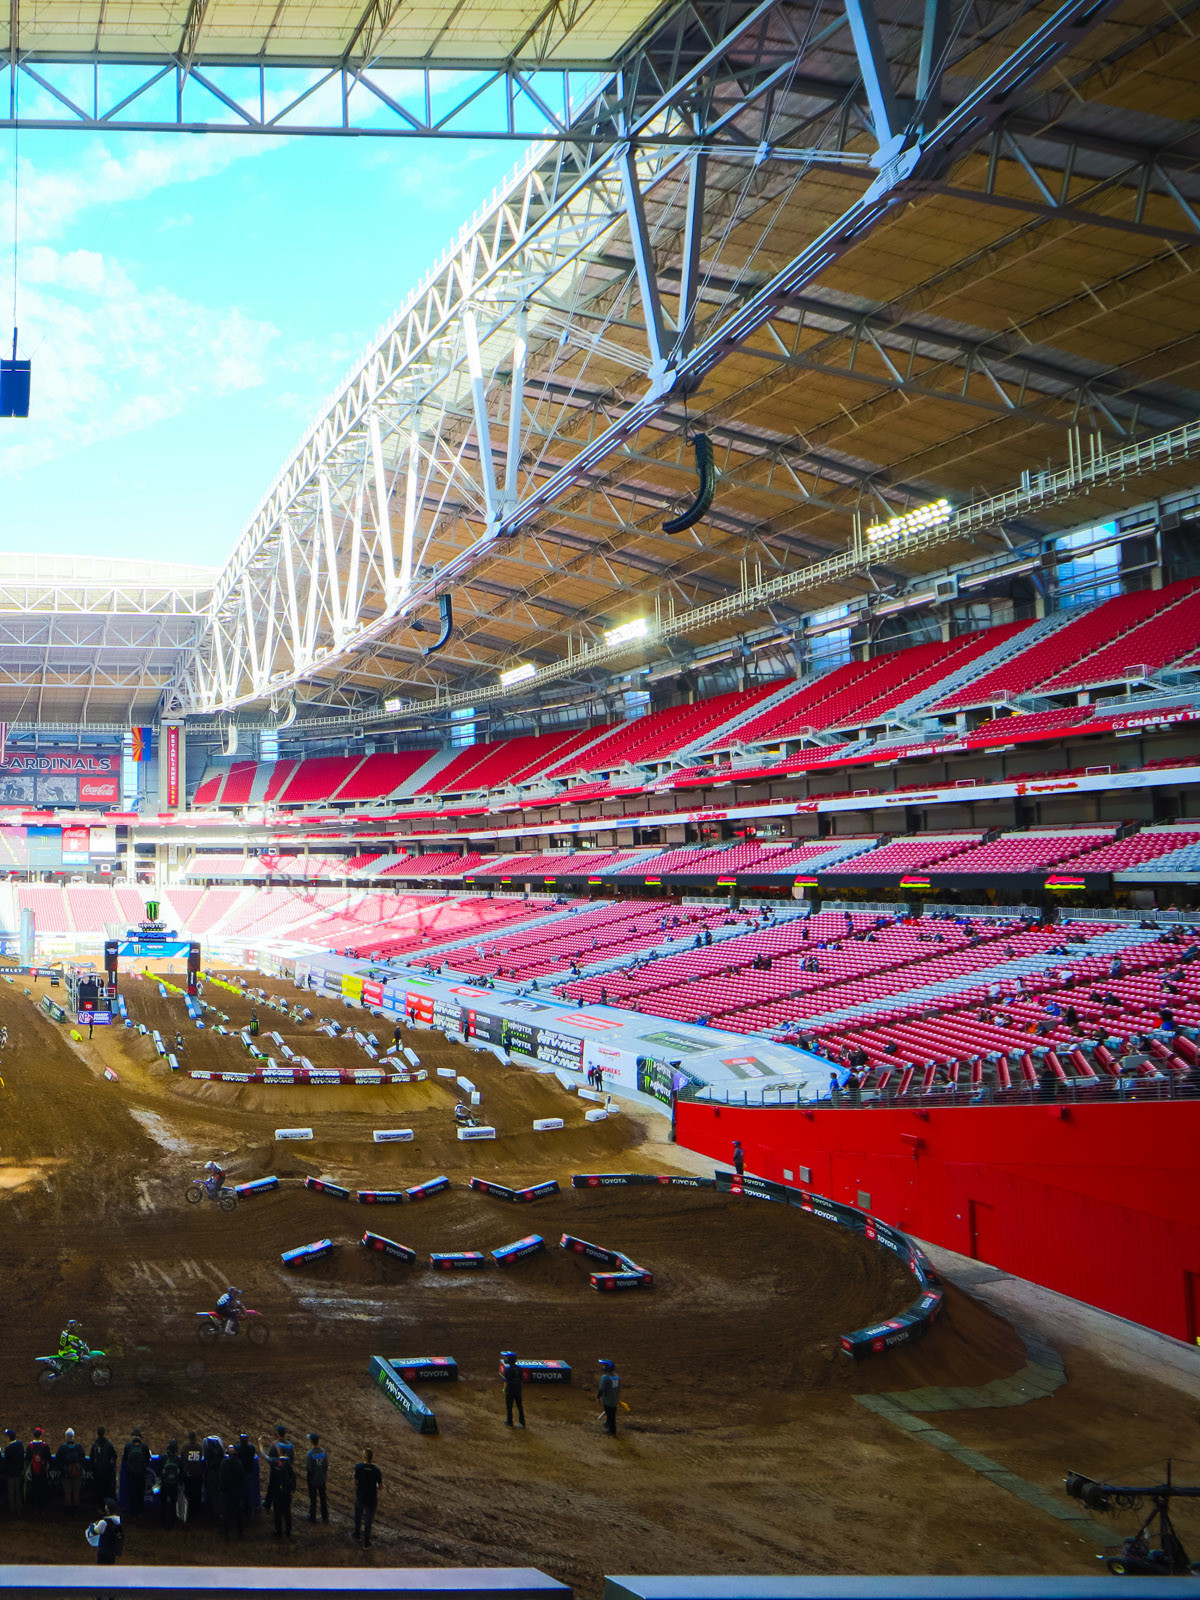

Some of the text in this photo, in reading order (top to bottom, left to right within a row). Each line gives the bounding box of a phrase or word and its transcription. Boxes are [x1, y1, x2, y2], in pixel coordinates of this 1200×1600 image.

[1112, 721, 1125, 729] 62
[1126, 712, 1185, 728] CHARLEY
[906, 748, 934, 757] ROGER
[1116, 774, 1142, 786] Ford
[81, 783, 116, 796] Coca-Cola
[476, 1015, 491, 1024] TOYOTA
[508, 1022, 533, 1035] MONSTER
[672, 1178, 698, 1187] TOYOTA
[744, 1178, 766, 1188] TOYOTA
[253, 1184, 274, 1194] TOYOTA
[324, 1187, 344, 1198] TOYOTA
[426, 1184, 445, 1195] TOYOTA
[489, 1187, 508, 1198] TOYOTA
[534, 1186, 554, 1197] TOYOTA
[744, 1189, 771, 1201] TOYOTA
[812, 1197, 833, 1208] TOYOTA
[814, 1208, 838, 1223] TOYOTA
[875, 1223, 893, 1237] TOYOTA
[877, 1234, 898, 1251] TOYOTA
[304, 1251, 328, 1261] TOYOTA
[386, 1247, 408, 1260] TOYOTA
[516, 1245, 540, 1257] TOYOTA
[586, 1249, 609, 1262] TOYOTA
[885, 1331, 910, 1346] TOYOTA
[419, 1369, 449, 1378] TOYOTA
[532, 1371, 563, 1380] TOYOTA
[386, 1378, 412, 1411] MONSTER
